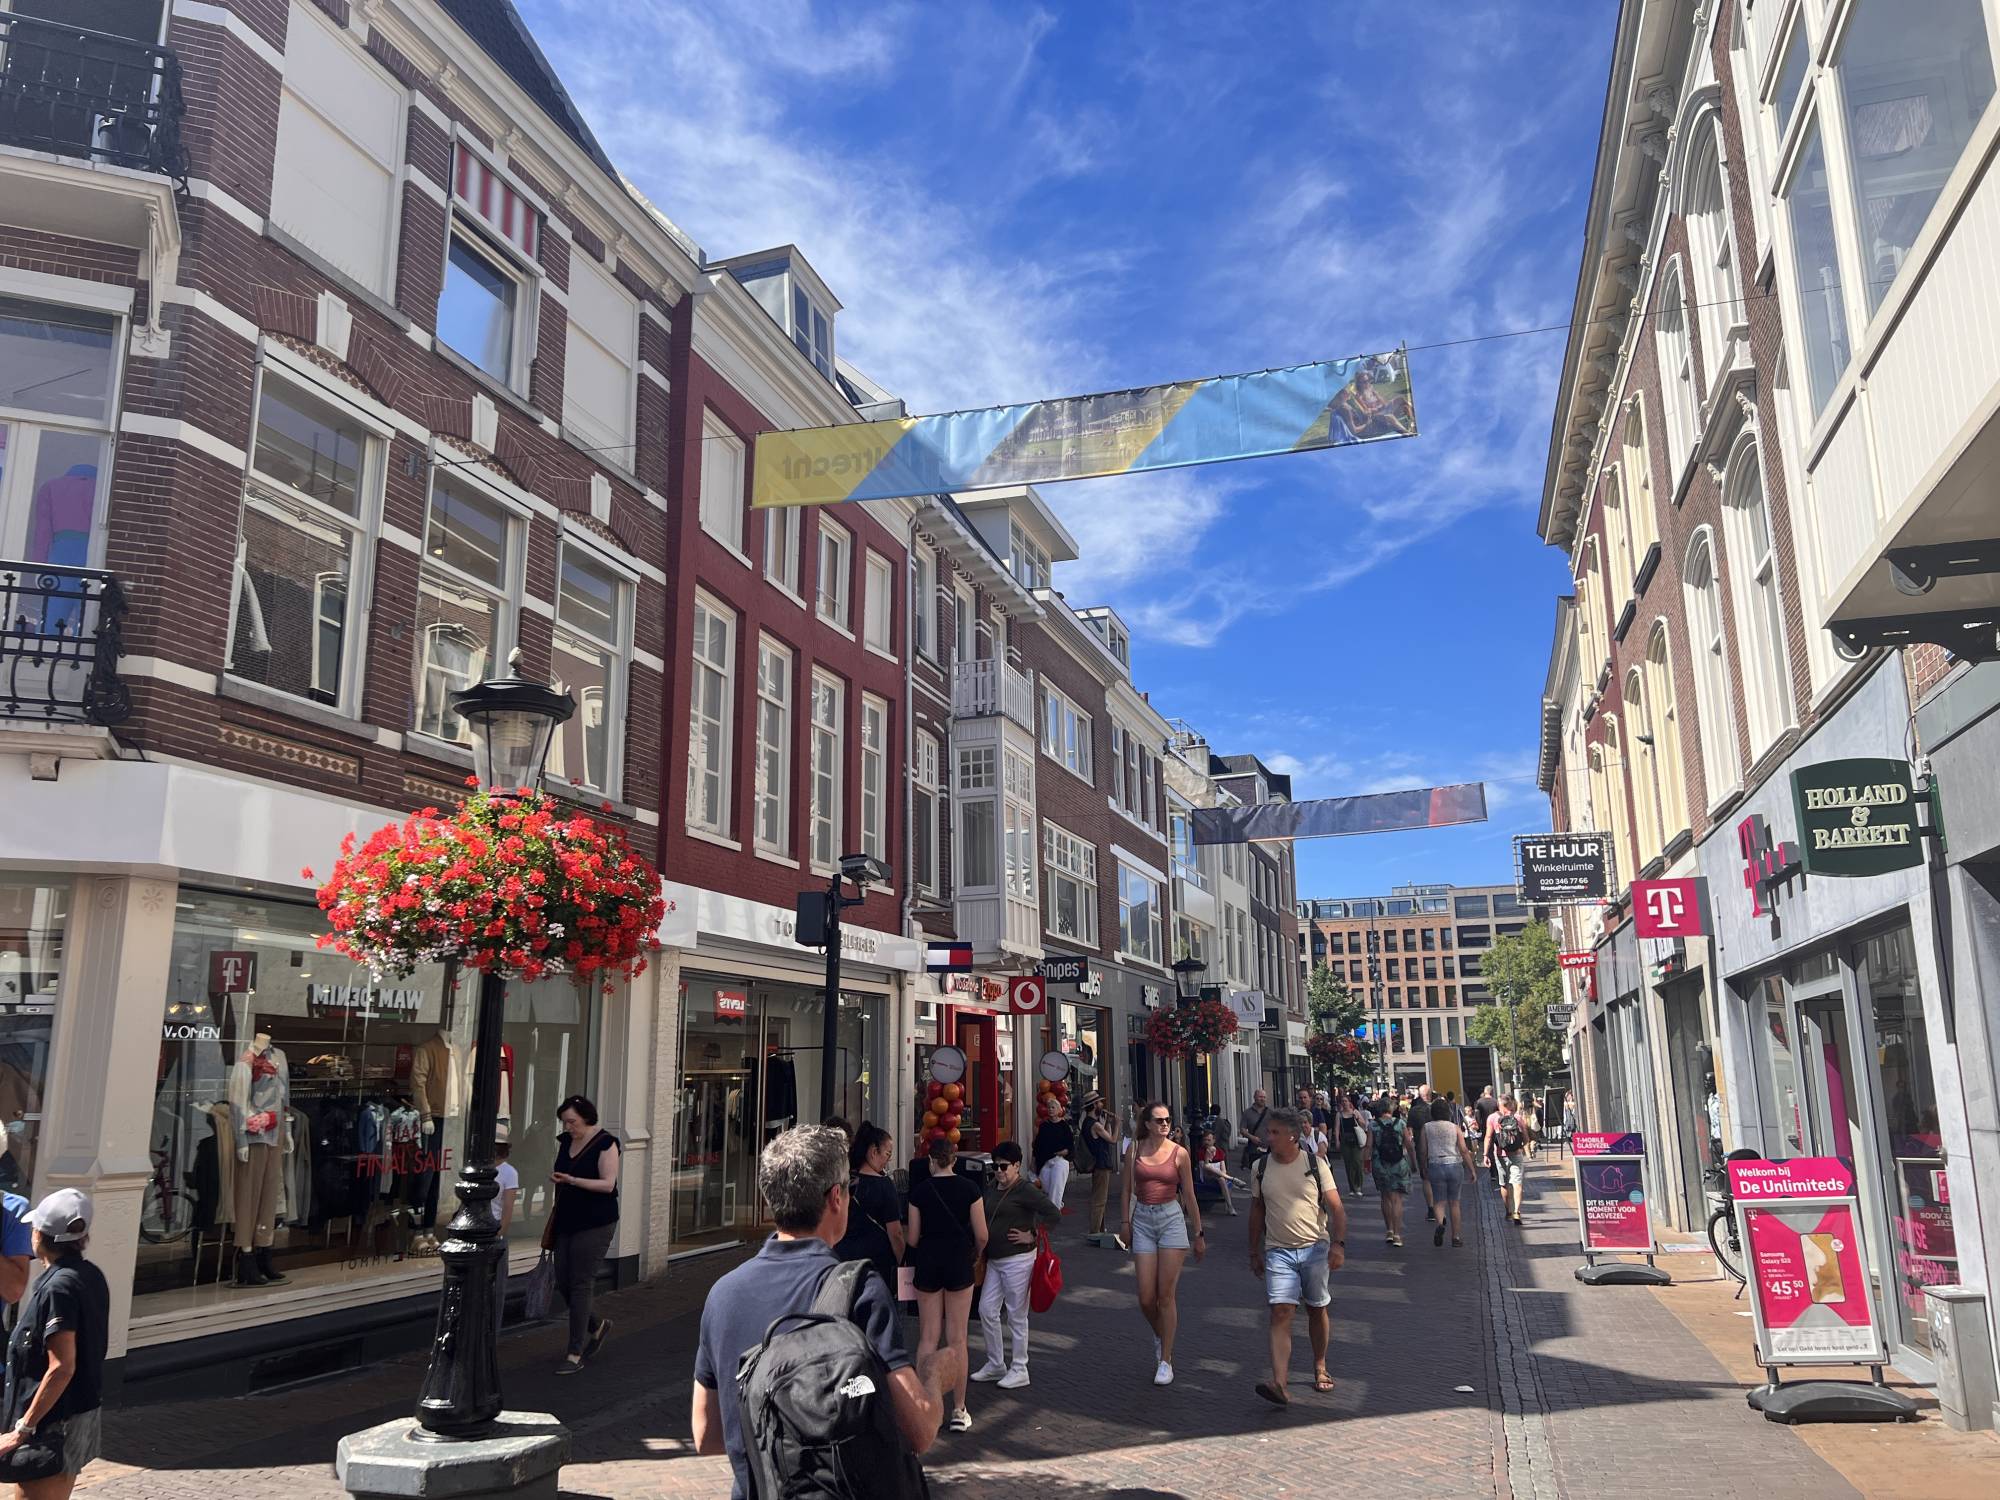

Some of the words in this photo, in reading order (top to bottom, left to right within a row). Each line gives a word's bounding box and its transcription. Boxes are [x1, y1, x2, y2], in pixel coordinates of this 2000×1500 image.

[1805, 783, 1907, 809] HOLLAND
[1851, 806, 1871, 826] &
[1812, 823, 1911, 849] BARRETT
[1525, 844, 1547, 858] TE
[1551, 842, 1599, 857] HUUR
[1532, 862, 1595, 872] Winkelruimte
[1646, 887, 1684, 928] T
[1038, 962, 1079, 980] snipes
[356, 1151, 408, 1178] FINAL
[414, 1148, 453, 1174] SALE
[1736, 1168, 1777, 1178] Welkom
[1778, 1166, 1792, 1178] bij
[1739, 1180, 1761, 1194] De
[1763, 1178, 1846, 1193] Unlimiteds
[1605, 1199, 1619, 1207] HET
